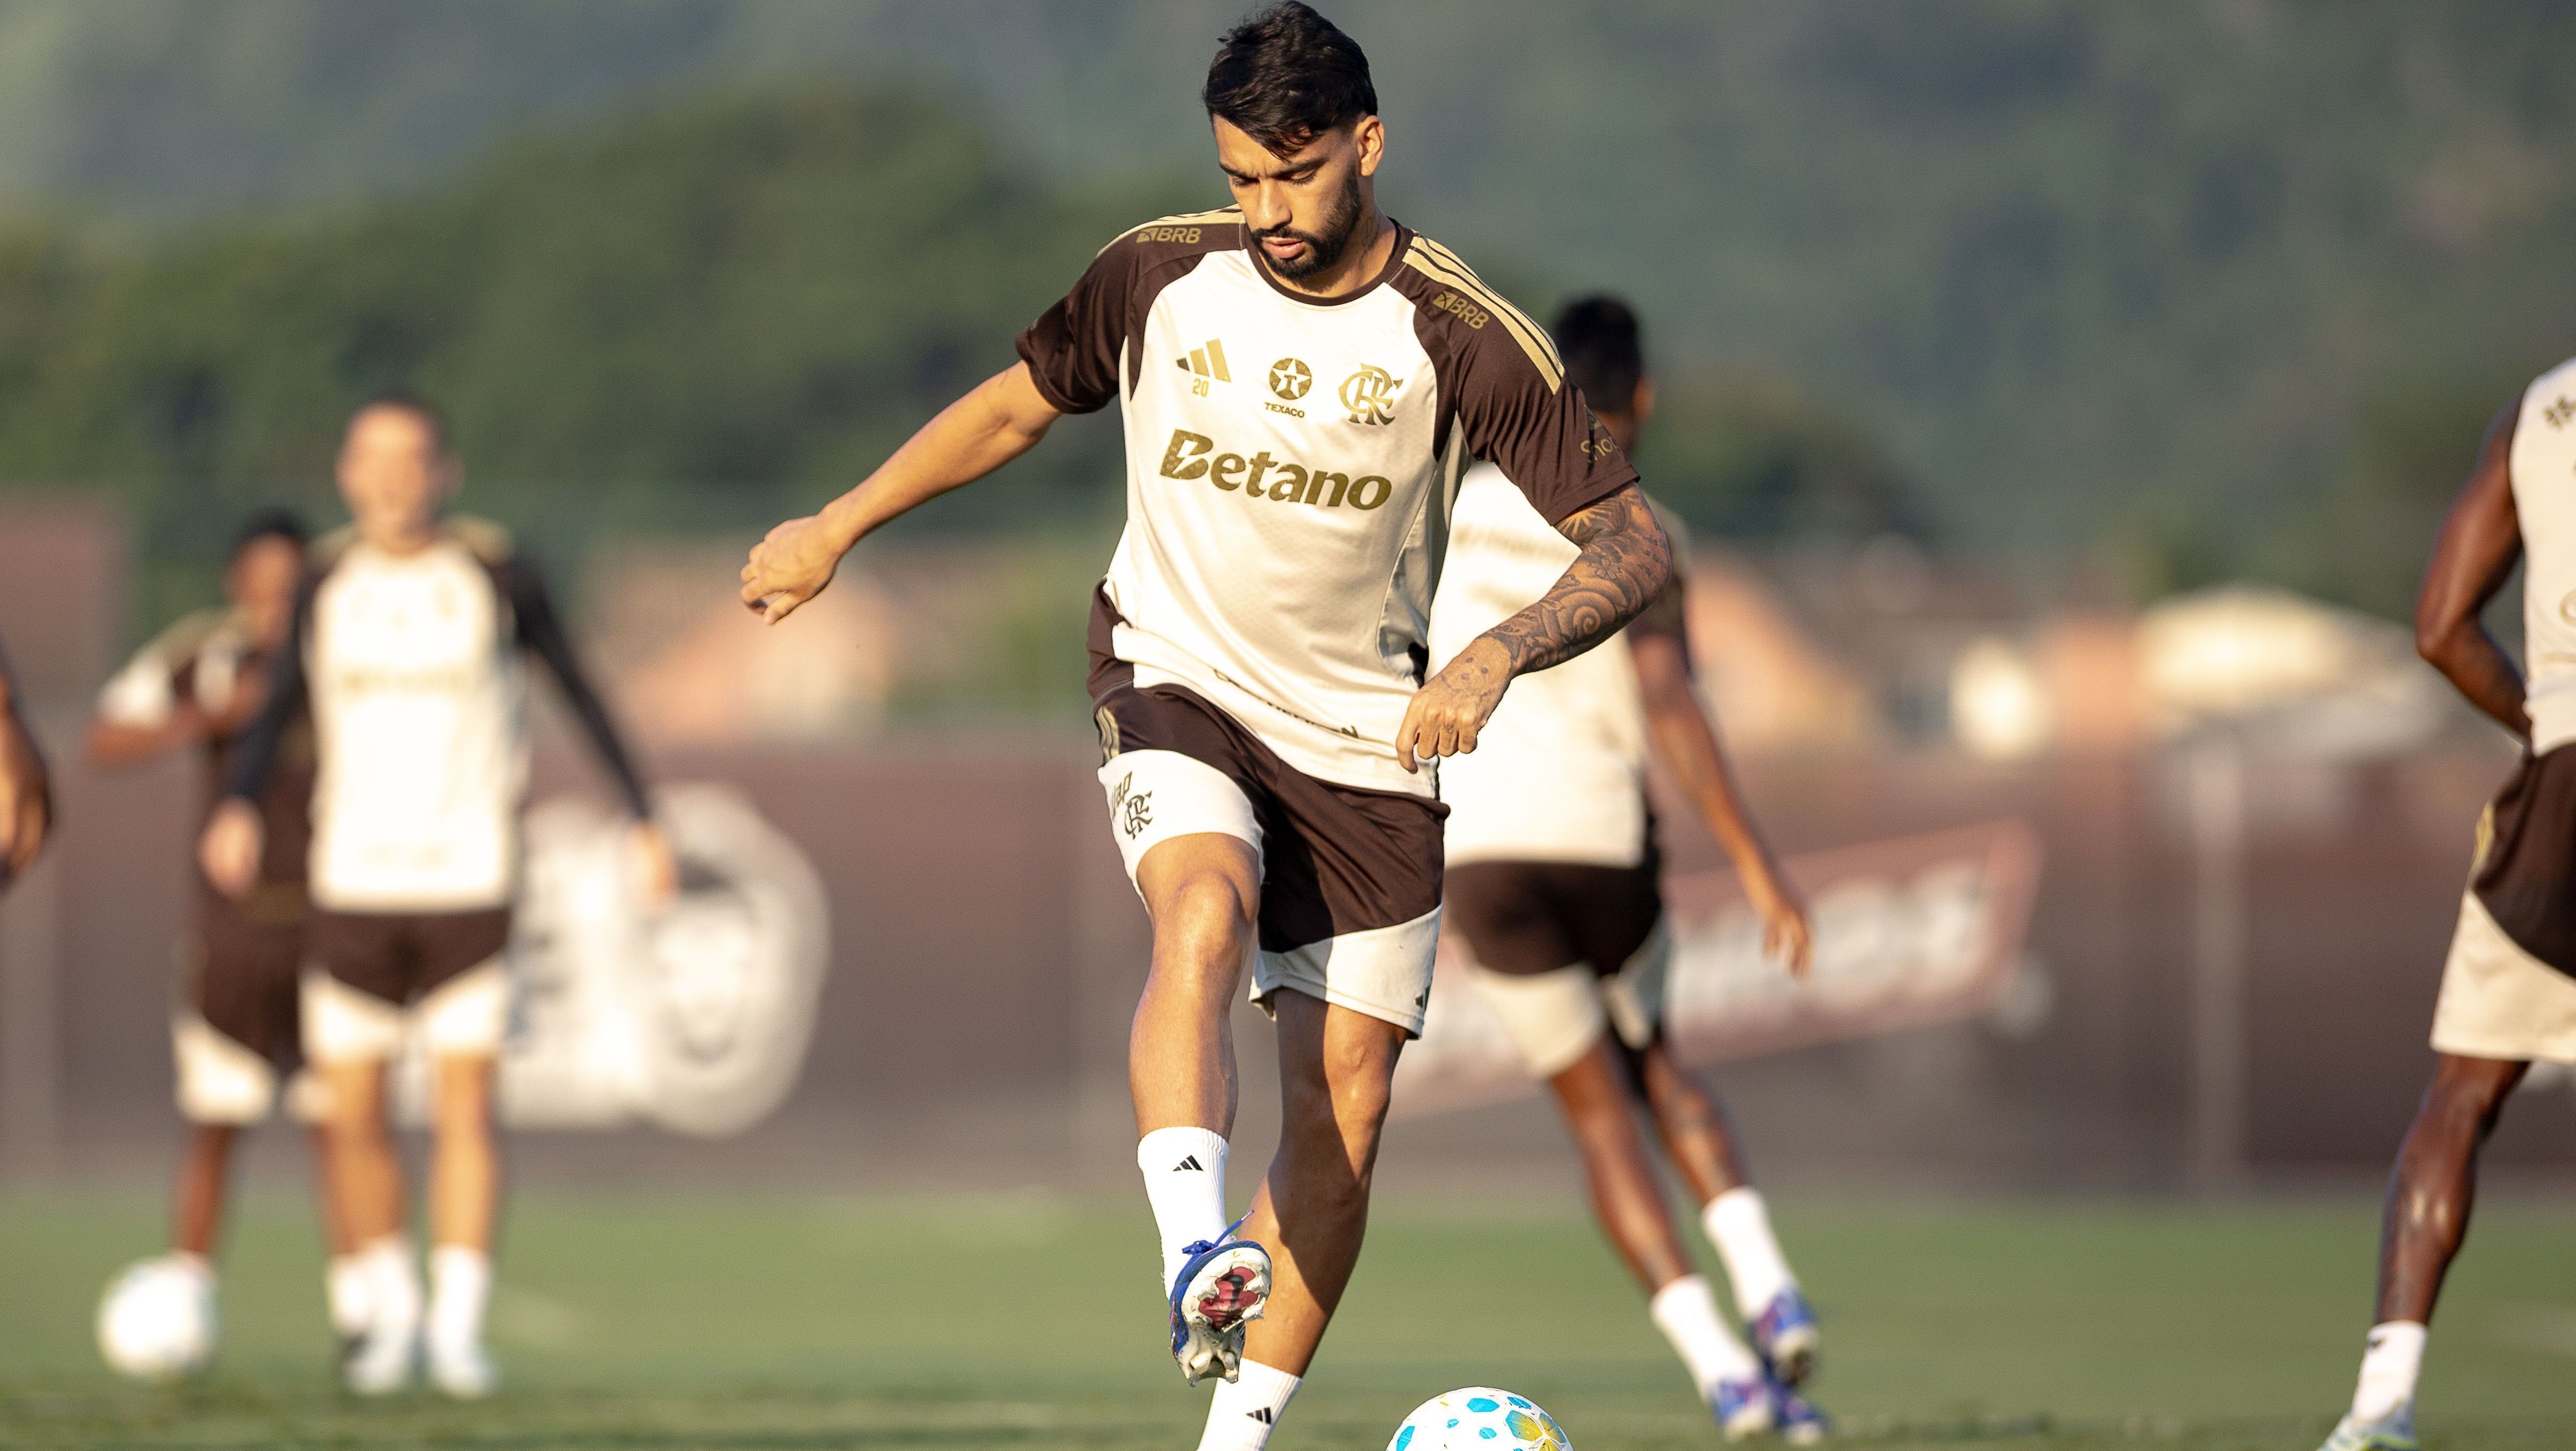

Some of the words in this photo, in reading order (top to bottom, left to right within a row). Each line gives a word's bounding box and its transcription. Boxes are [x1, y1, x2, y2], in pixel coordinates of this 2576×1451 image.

[1156, 227, 1202, 244] BRB
[1447, 297, 1489, 330] BRB
[1191, 377, 1210, 397] 20
[1264, 402, 1305, 419] TEXACO
[1159, 428, 1392, 511] Betano
